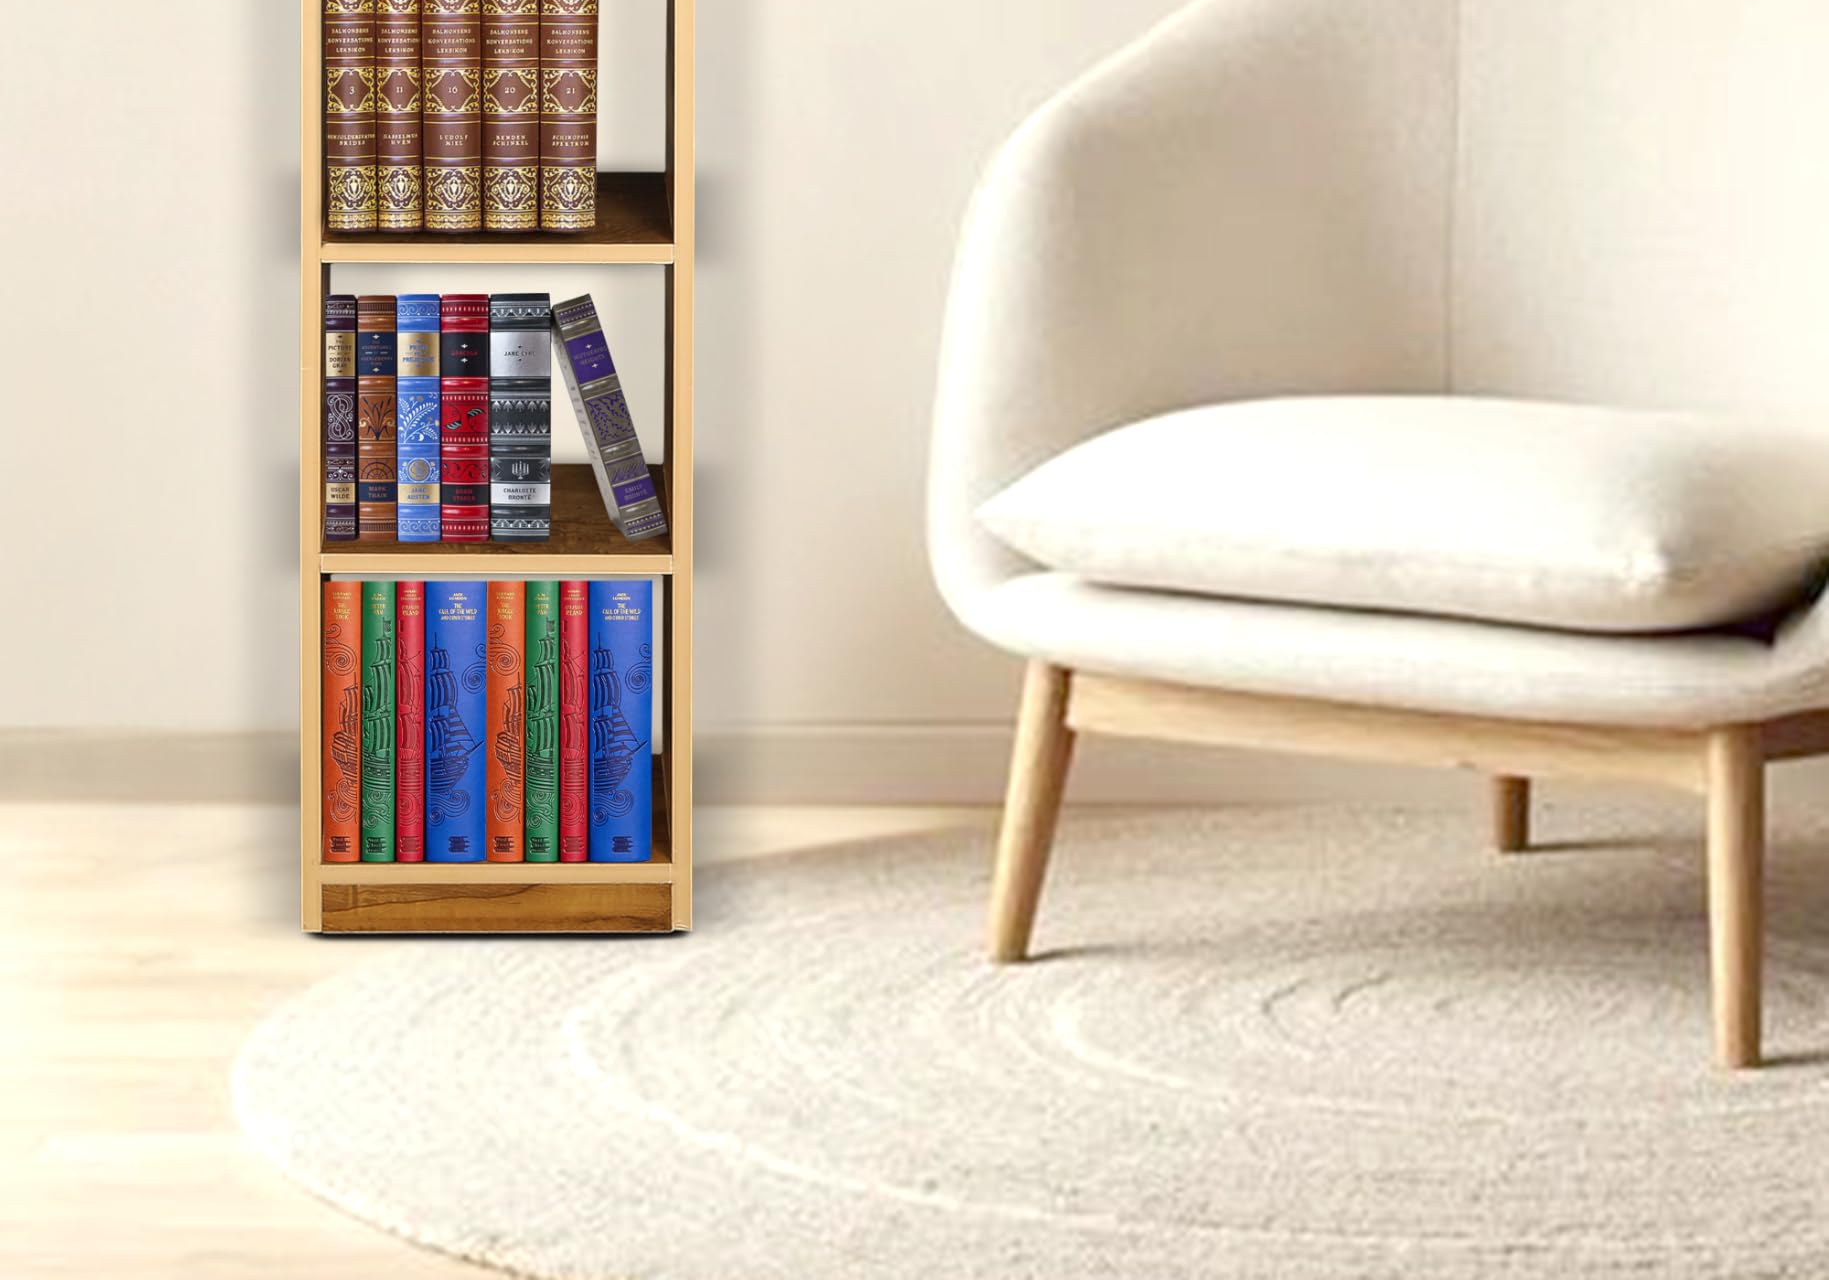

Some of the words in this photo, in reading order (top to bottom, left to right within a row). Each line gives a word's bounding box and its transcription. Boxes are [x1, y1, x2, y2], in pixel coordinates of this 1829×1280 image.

[349, 86, 355, 95] 3
[448, 87, 458, 95] 16
[504, 87, 516, 95] 20
[566, 87, 575, 95] 21
